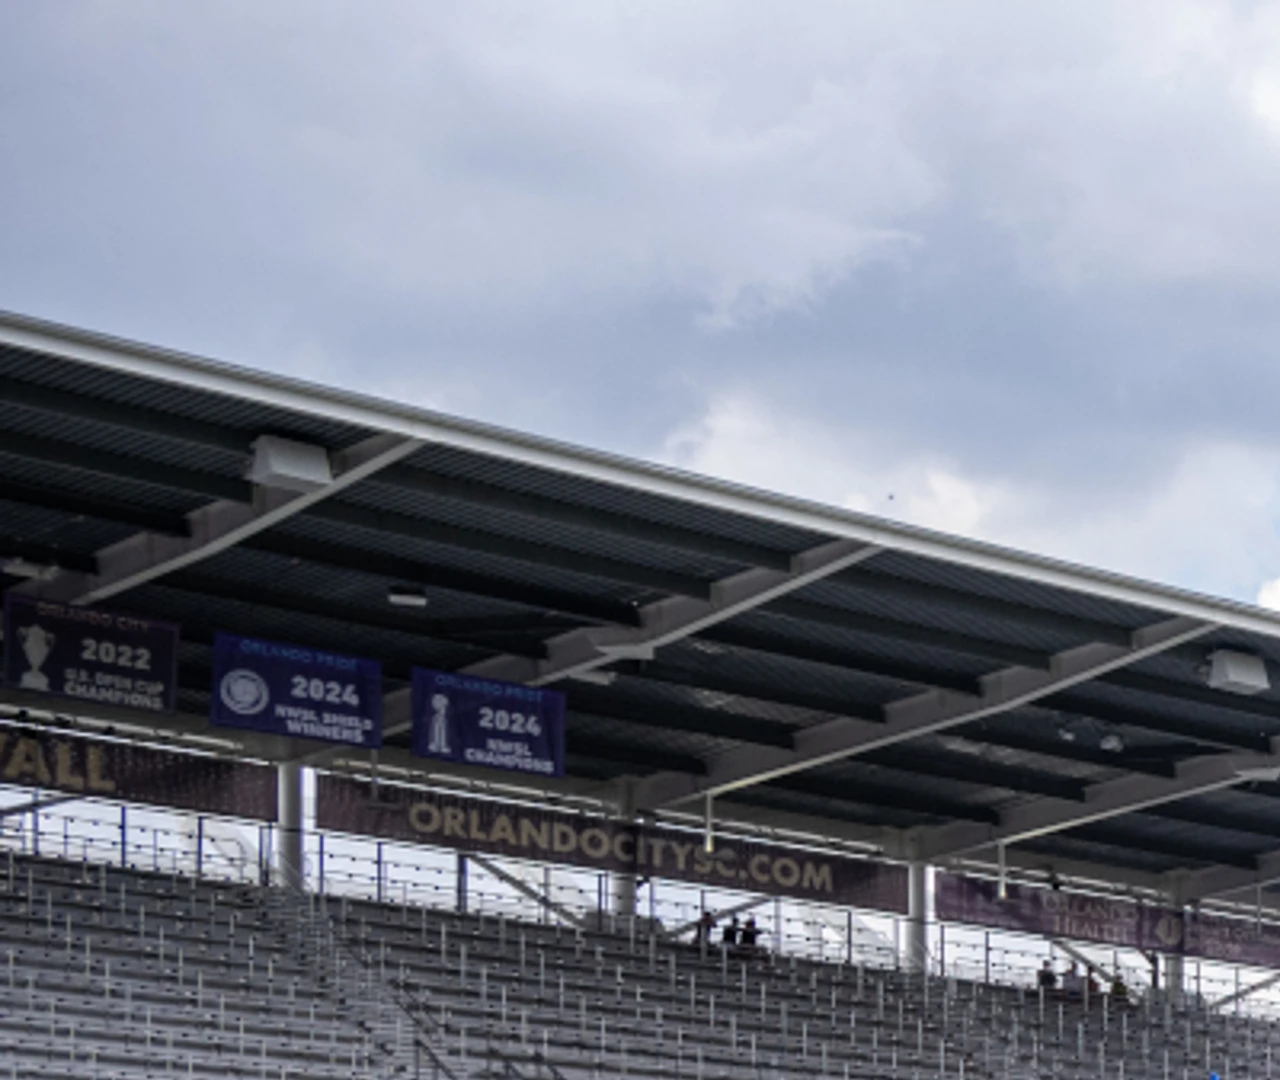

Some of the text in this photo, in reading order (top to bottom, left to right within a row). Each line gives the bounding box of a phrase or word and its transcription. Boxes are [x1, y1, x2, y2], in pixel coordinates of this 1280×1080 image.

[81, 638, 150, 670] 2022
[240, 639, 357, 670] ORLANDO PRIDE
[64, 681, 163, 710] CHAMPIONS
[290, 675, 360, 707] 2024
[274, 704, 318, 721] NWSL
[478, 706, 541, 737] 2024
[286, 719, 365, 743] WINNERS
[0, 733, 116, 791] ALL
[464, 748, 554, 774] CHAMPIONS
[486, 738, 532, 757] NWSL
[408, 802, 834, 893] ORLANDOCITYSC.COM
